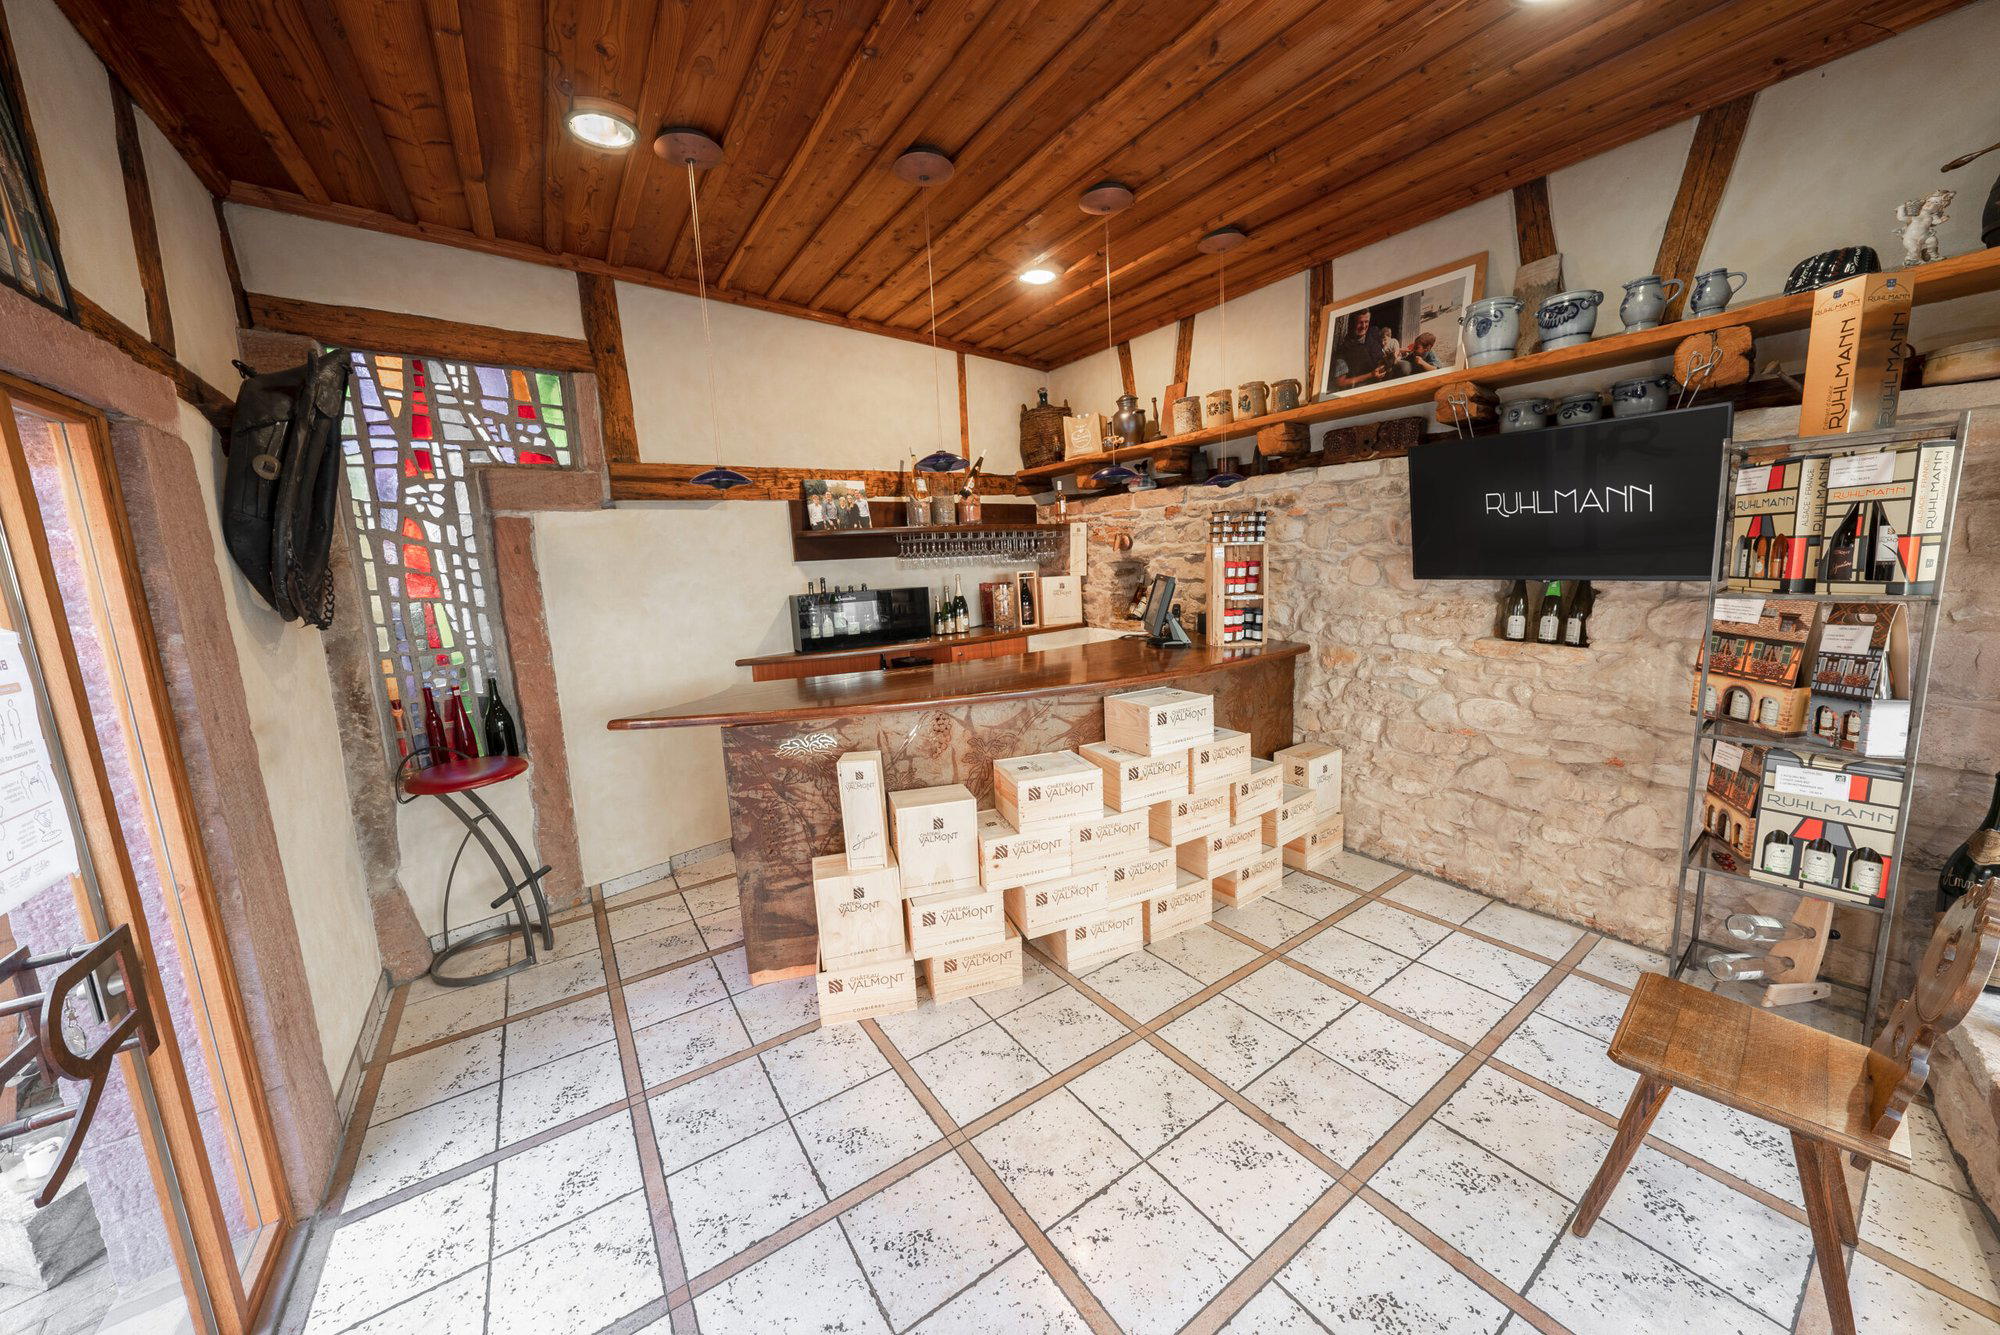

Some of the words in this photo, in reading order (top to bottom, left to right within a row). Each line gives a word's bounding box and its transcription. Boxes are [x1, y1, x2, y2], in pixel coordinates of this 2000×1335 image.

[1814, 299, 1861, 316] RUHLMANN
[1868, 293, 1911, 302] RUHLMANN
[1828, 317, 1856, 430] RUHLMANN
[1879, 312, 1907, 428] RUHLMANN
[1805, 468, 1815, 496] FRANCE
[1833, 484, 1907, 500] RUHLMANN
[1926, 450, 1943, 529] RUHLMANN
[1485, 484, 1653, 518] RUHLMANN
[1737, 495, 1795, 511] RUHLMANN
[1801, 501, 1811, 527] ALSACE
[1170, 708, 1207, 726] VALMONT
[1212, 745, 1245, 764] VALMONT
[1142, 761, 1181, 780] VALMONT
[1045, 782, 1094, 802] VALMONT
[1190, 796, 1224, 814] VALMONT
[1766, 793, 1894, 825] RUHLMANN
[918, 832, 958, 847] VALMONT
[1096, 821, 1142, 842] VALMONT
[1012, 839, 1062, 859] VALMONT
[1129, 859, 1168, 880] VALMONT
[1052, 883, 1099, 906] VALMONT
[1170, 890, 1206, 911] VALMONT
[838, 901, 880, 917] VALMONT
[941, 905, 994, 926] VALMONT
[1090, 917, 1134, 939] VALMONT
[962, 950, 1014, 972] VALMONT
[848, 972, 904, 994] VALMONT
